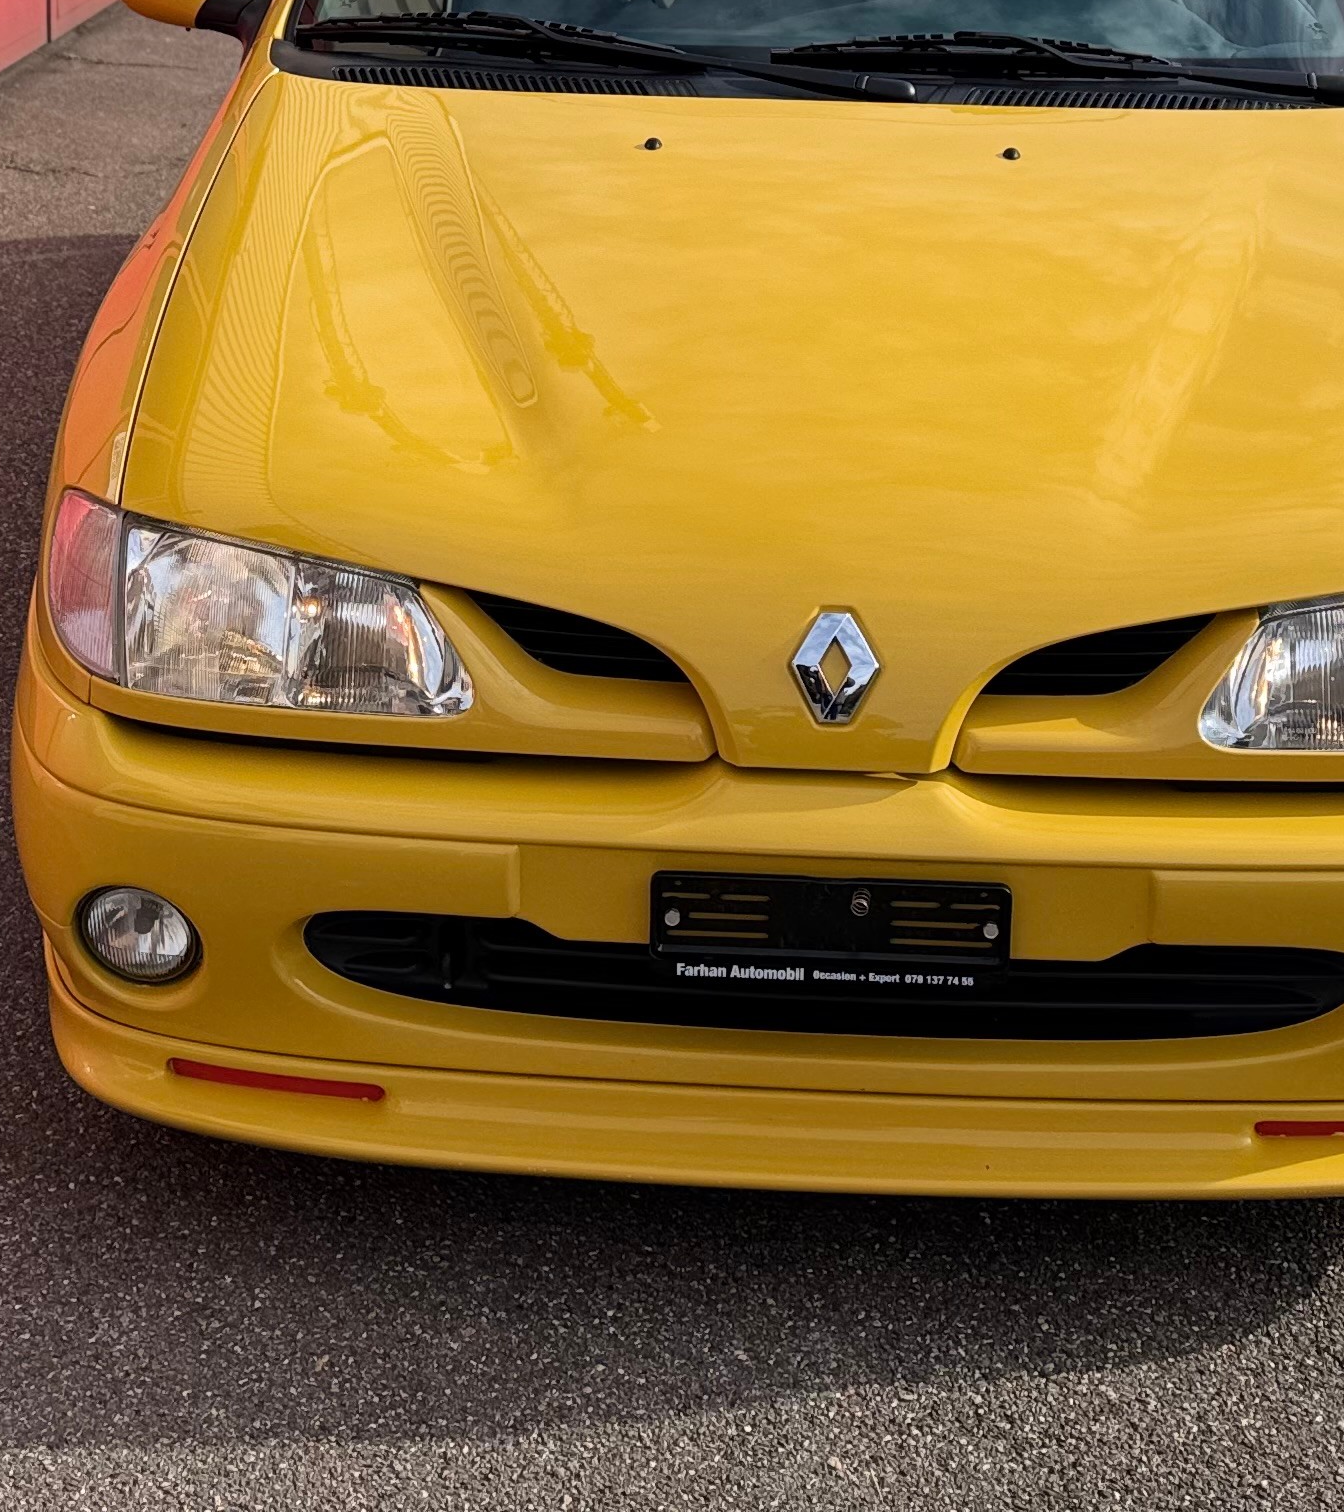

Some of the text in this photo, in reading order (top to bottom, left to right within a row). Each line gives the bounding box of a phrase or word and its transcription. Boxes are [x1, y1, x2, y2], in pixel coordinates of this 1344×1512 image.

[676, 962, 727, 978] Farhan
[730, 964, 805, 981] Automobil
[813, 970, 857, 981] Occasion
[869, 973, 900, 984] Export
[926, 975, 945, 985] 137
[947, 976, 959, 986] 74
